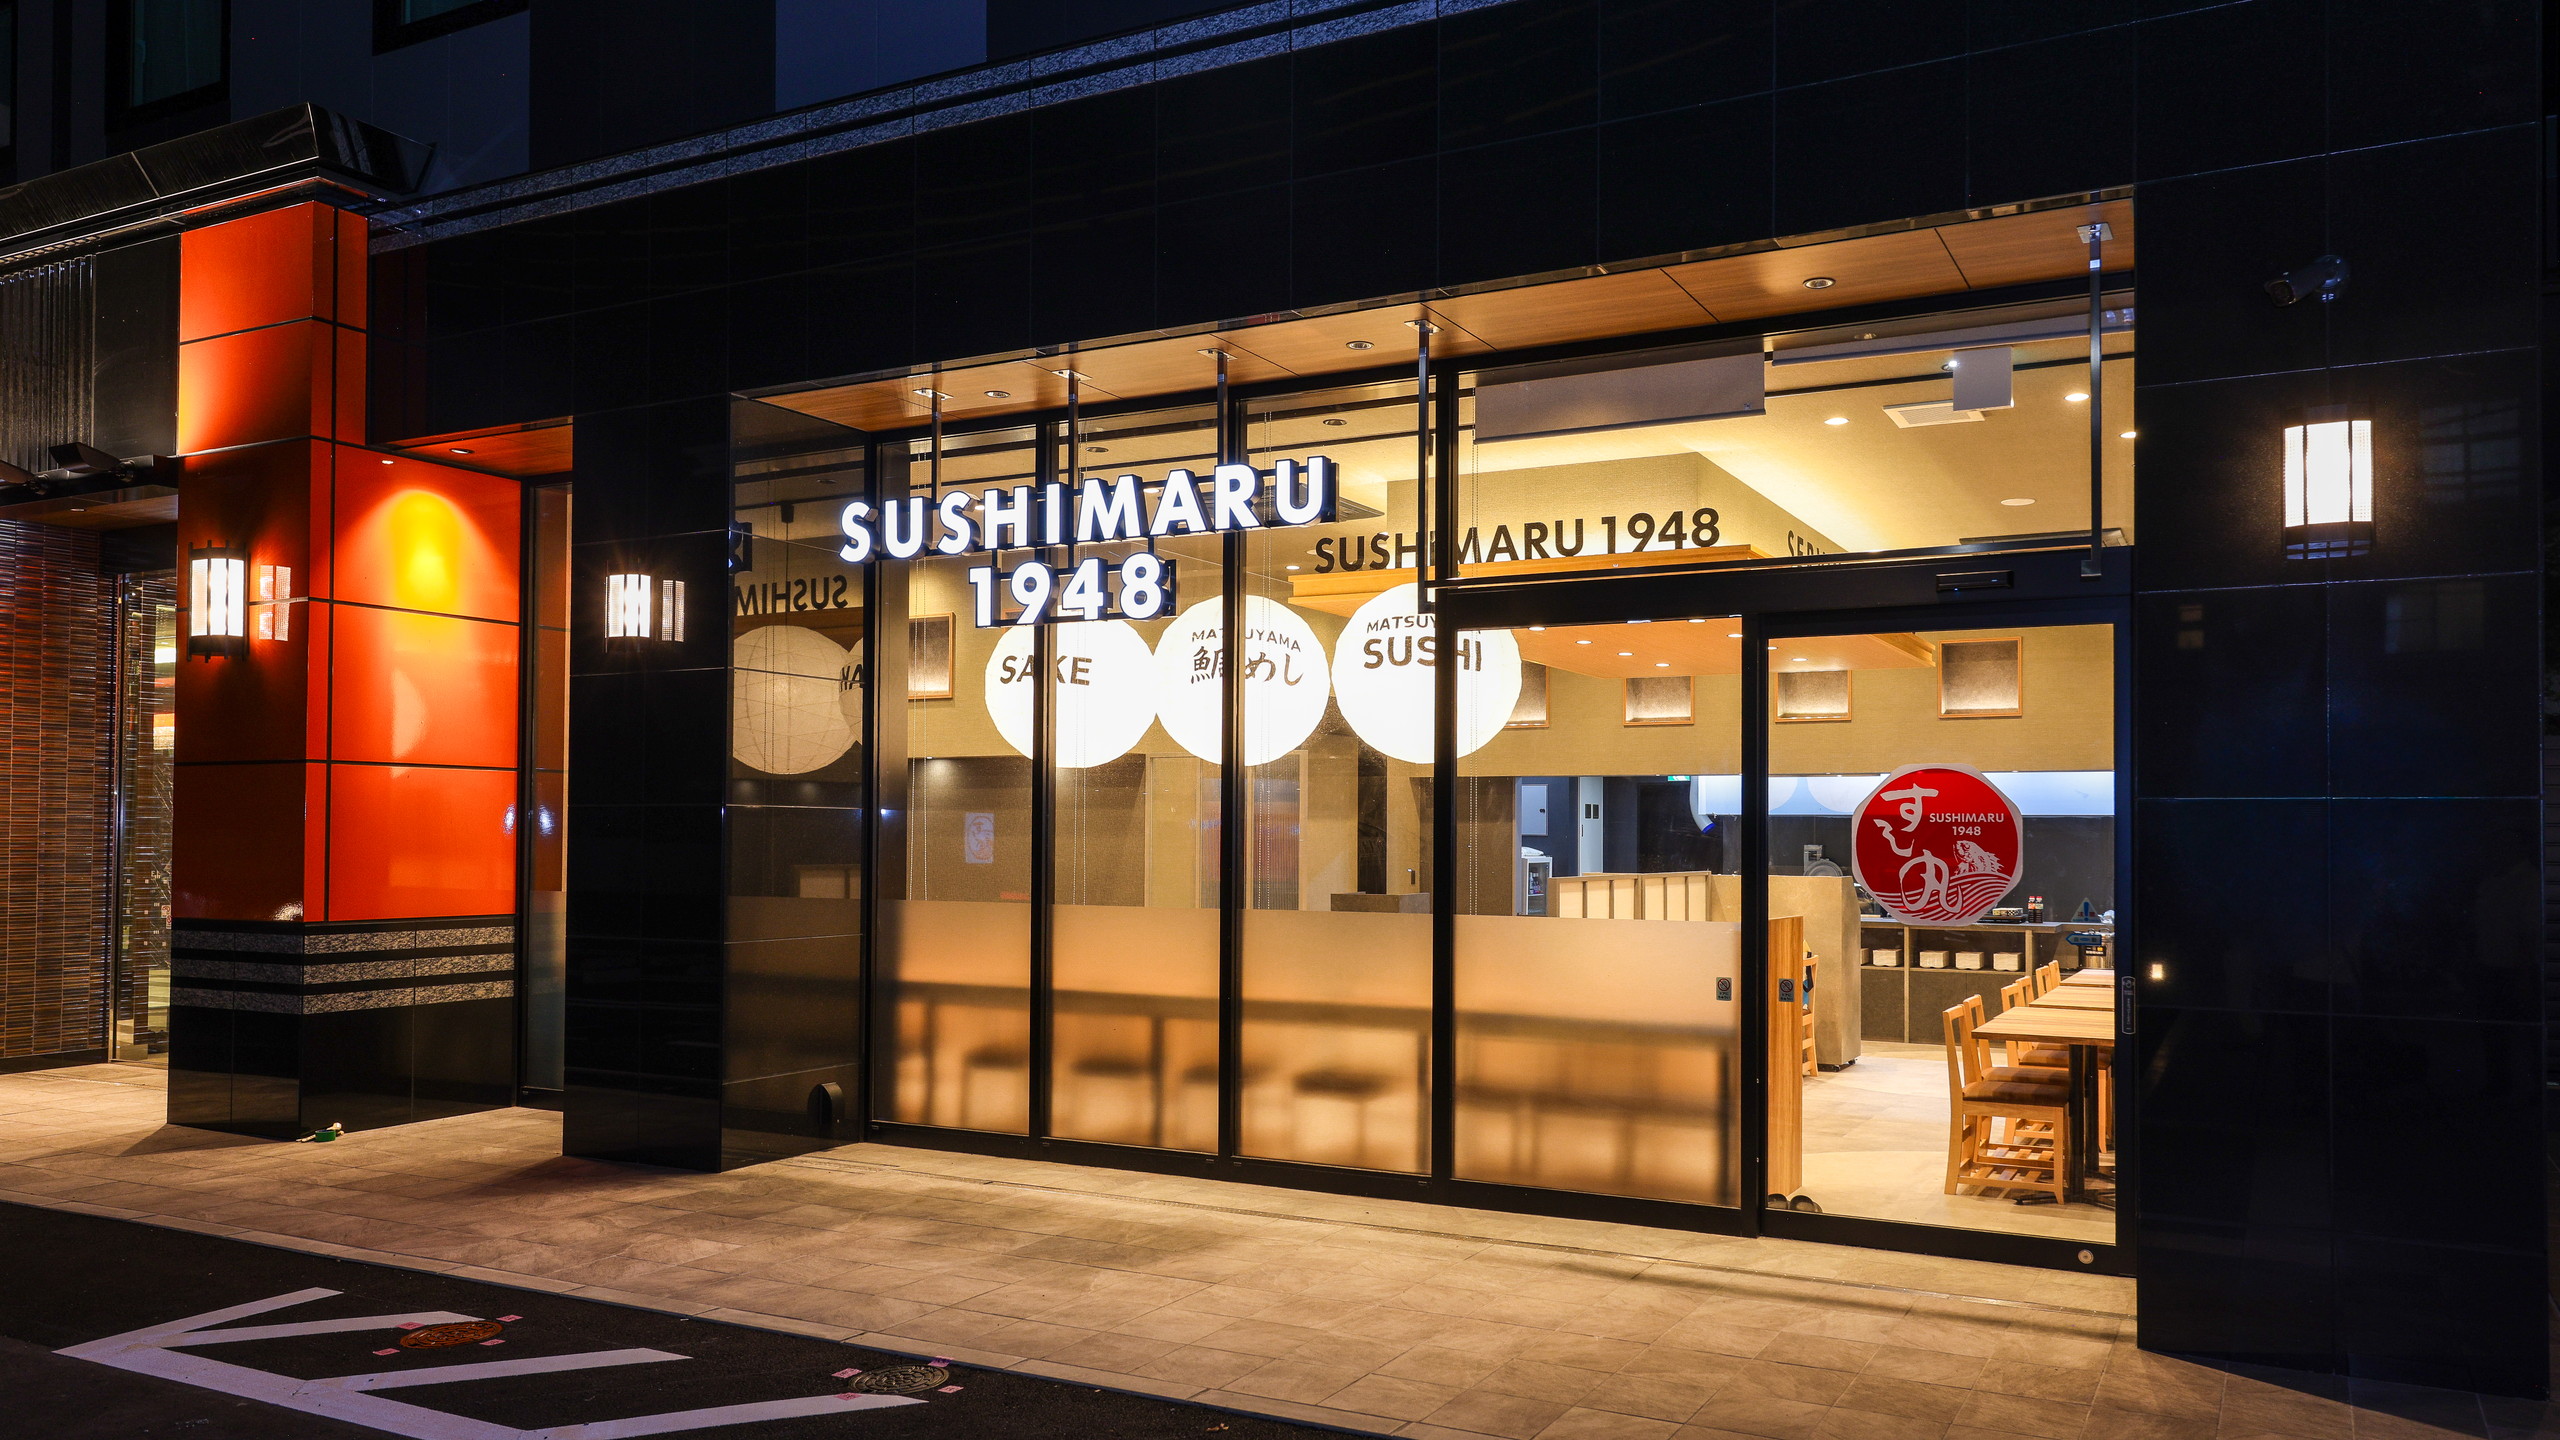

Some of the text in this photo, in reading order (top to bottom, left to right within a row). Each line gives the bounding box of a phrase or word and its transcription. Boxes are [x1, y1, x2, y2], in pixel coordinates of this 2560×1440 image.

[838, 456, 1329, 563] SUSHIMARU
[1601, 507, 1720, 554] 1948
[968, 552, 1166, 627] 1948
[1191, 628, 1301, 652] MAUYAMA
[1929, 812, 2005, 824] SUSHIMARU
[1952, 825, 1982, 836] 1948
